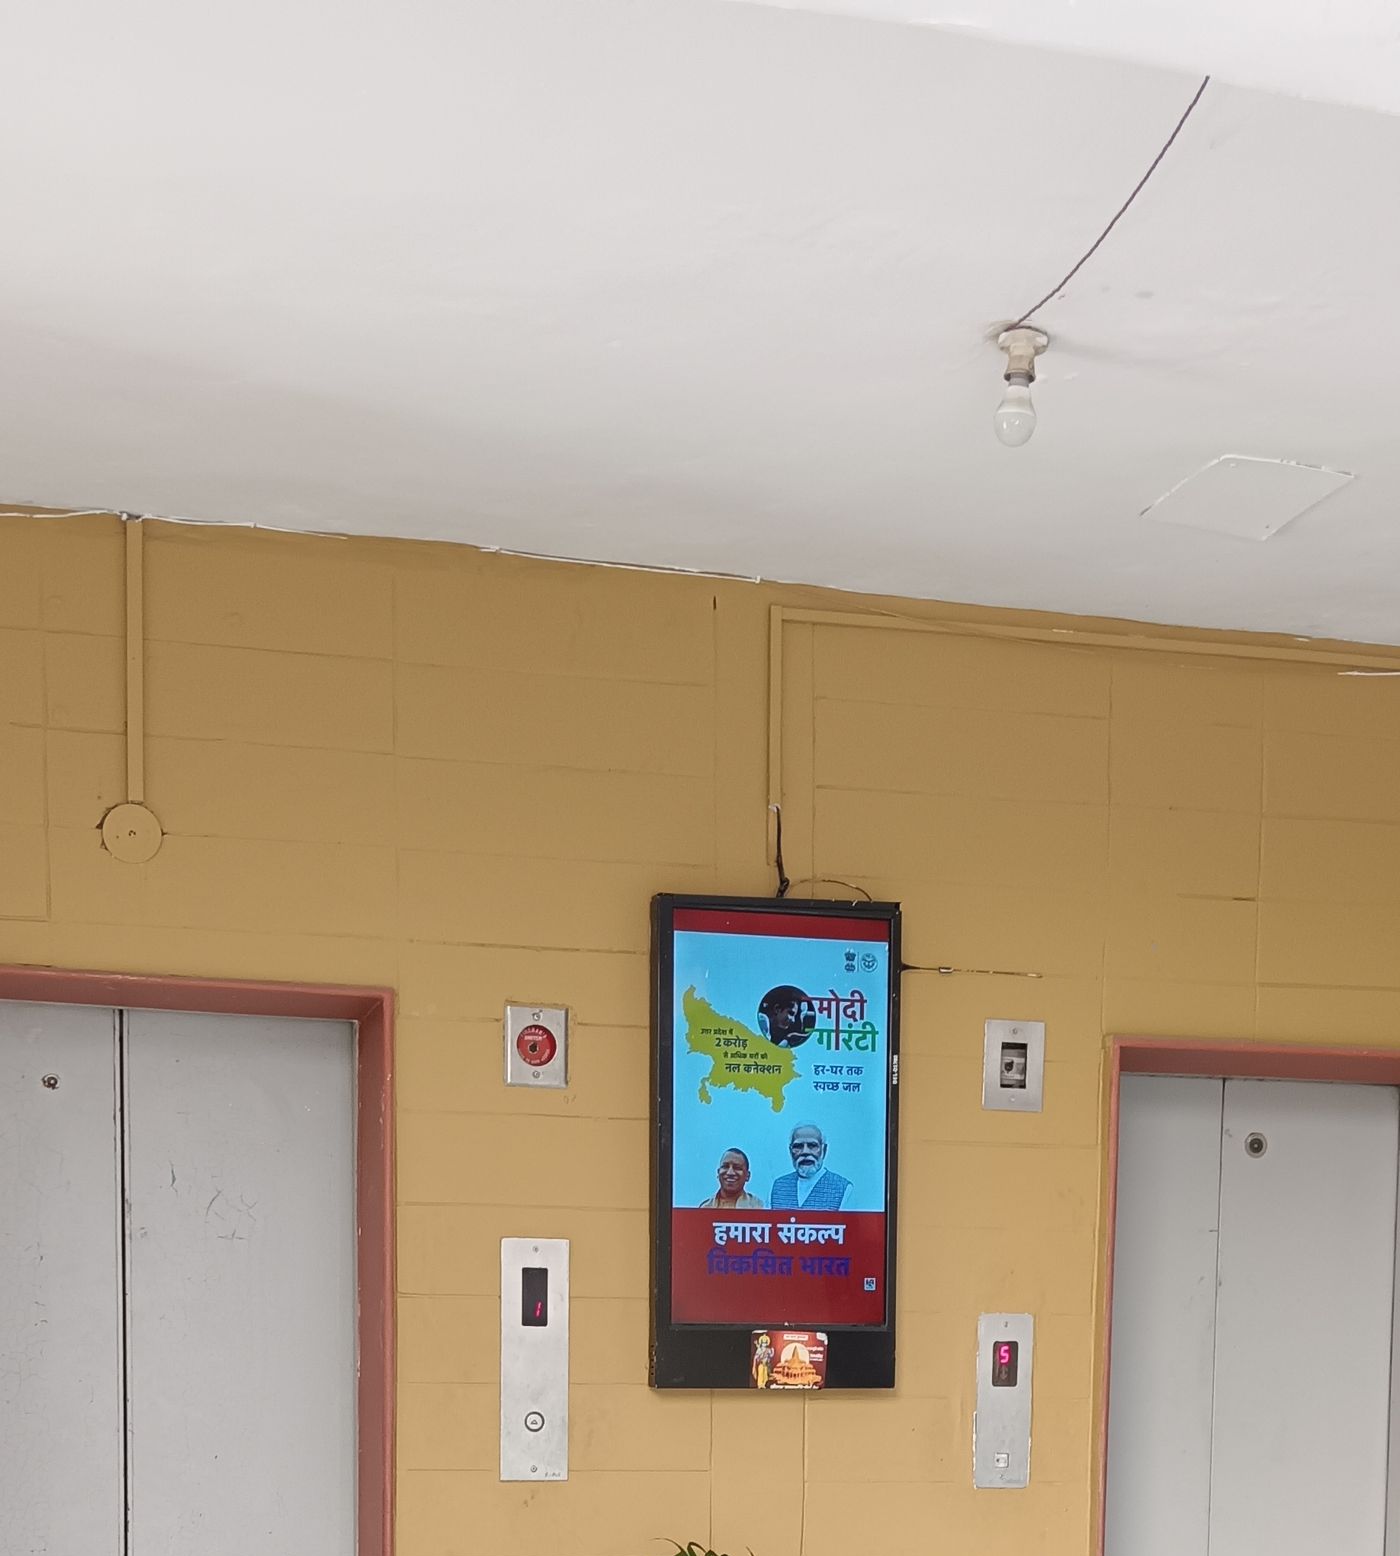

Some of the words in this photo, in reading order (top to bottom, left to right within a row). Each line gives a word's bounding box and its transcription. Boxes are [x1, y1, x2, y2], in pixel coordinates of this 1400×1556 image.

[802, 989, 867, 1022] मोदी
[715, 1037, 722, 1047] 2
[723, 1035, 748, 1050] करोड़
[805, 1021, 879, 1052] गारंटी
[725, 1063, 741, 1072] नल
[846, 1066, 864, 1076] तक
[813, 1081, 840, 1092] स्वच्छ
[842, 1082, 862, 1092] जल
[712, 1222, 772, 1246] हमारा
[777, 1216, 846, 1245] संकल्प
[706, 1248, 793, 1276] विकसित
[799, 1256, 852, 1276] भारत
